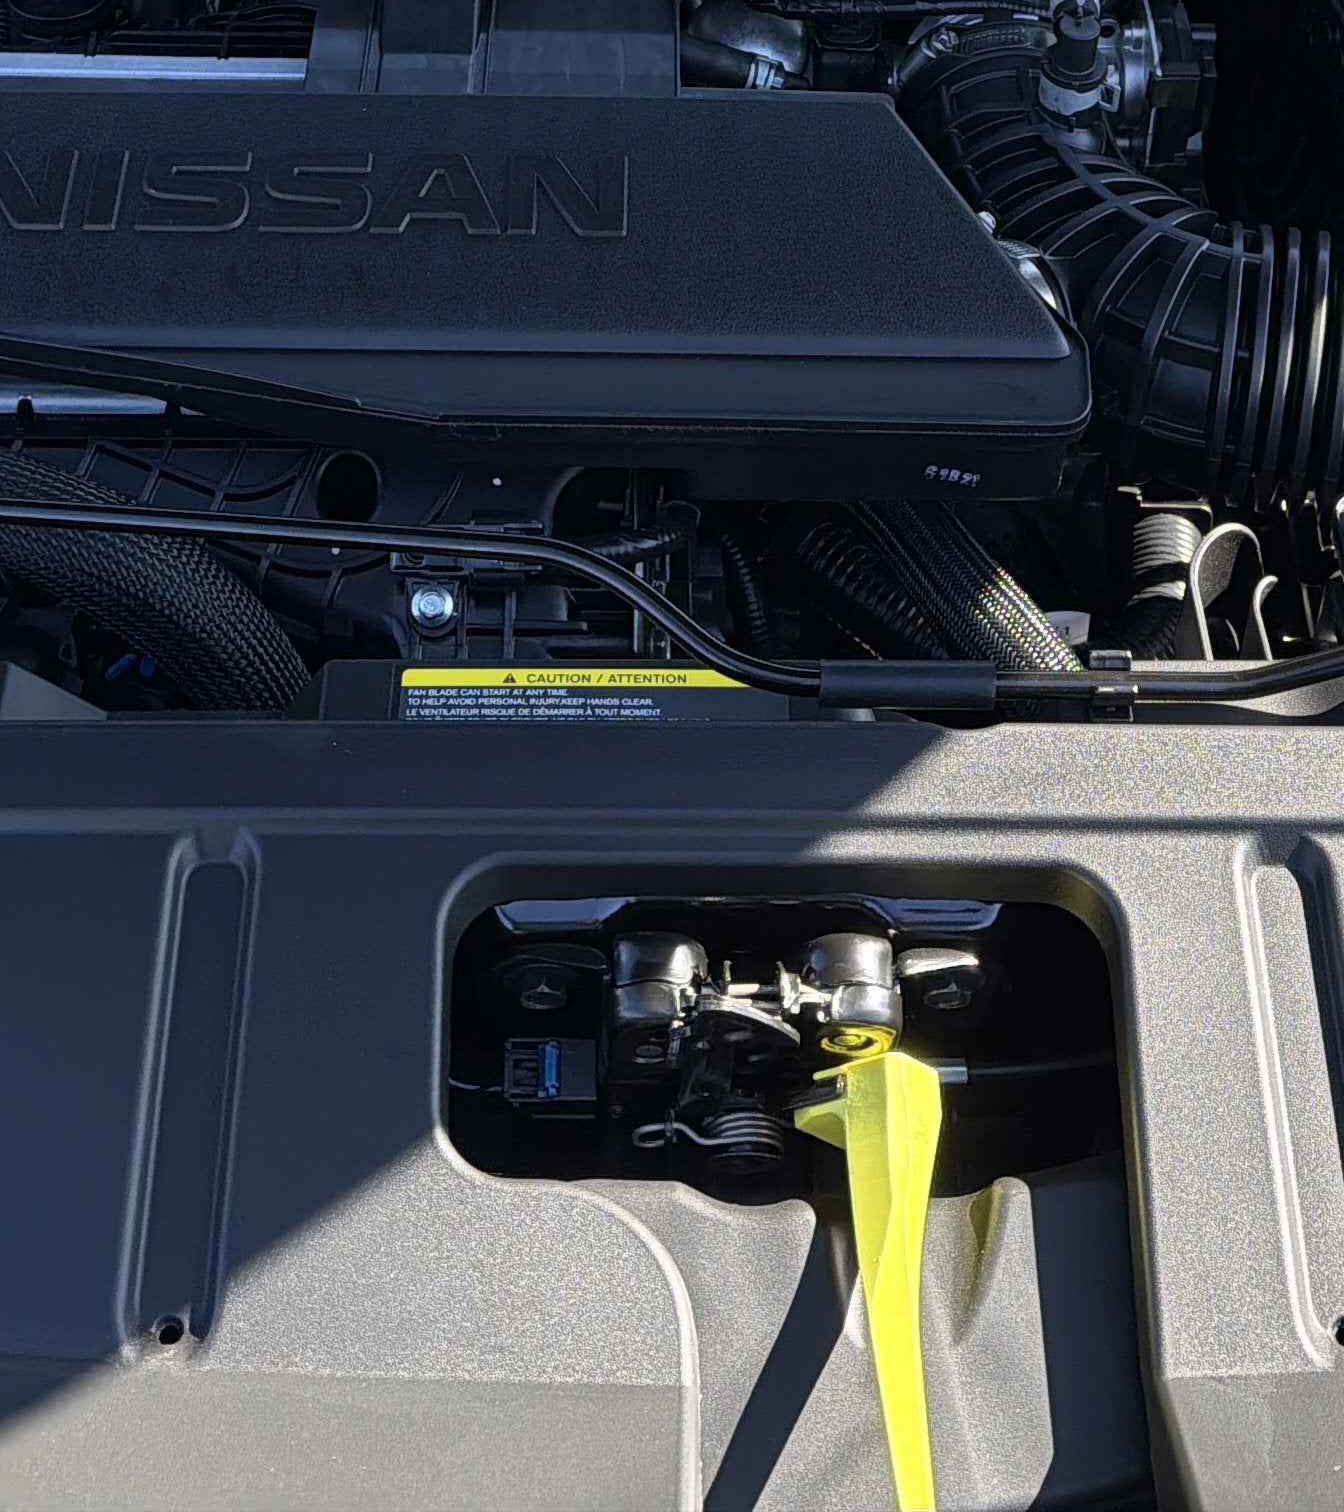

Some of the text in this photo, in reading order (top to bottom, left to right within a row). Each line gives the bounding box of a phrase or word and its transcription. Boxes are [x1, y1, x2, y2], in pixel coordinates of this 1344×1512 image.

[526, 673, 592, 684] CAUTION
[607, 673, 687, 684] ATTENTION
[408, 688, 426, 696] FAN
[428, 688, 459, 696] BLADE
[460, 688, 481, 696] CAN
[483, 688, 510, 696] START
[512, 688, 525, 696] AT
[525, 688, 545, 696] ANY
[408, 697, 421, 706] TO
[422, 697, 447, 706] HELP
[447, 697, 476, 706] AVOID
[478, 697, 528, 706] PERSONAL
[587, 697, 620, 706] HANDS
[406, 708, 418, 716] LE
[420, 708, 480, 716] VENTILATEUR
[480, 708, 516, 716] RISQUE
[518, 708, 531, 716] DE
[532, 706, 585, 716] DÉMARRER
[585, 706, 593, 716] À
[594, 708, 618, 716] TOUT
